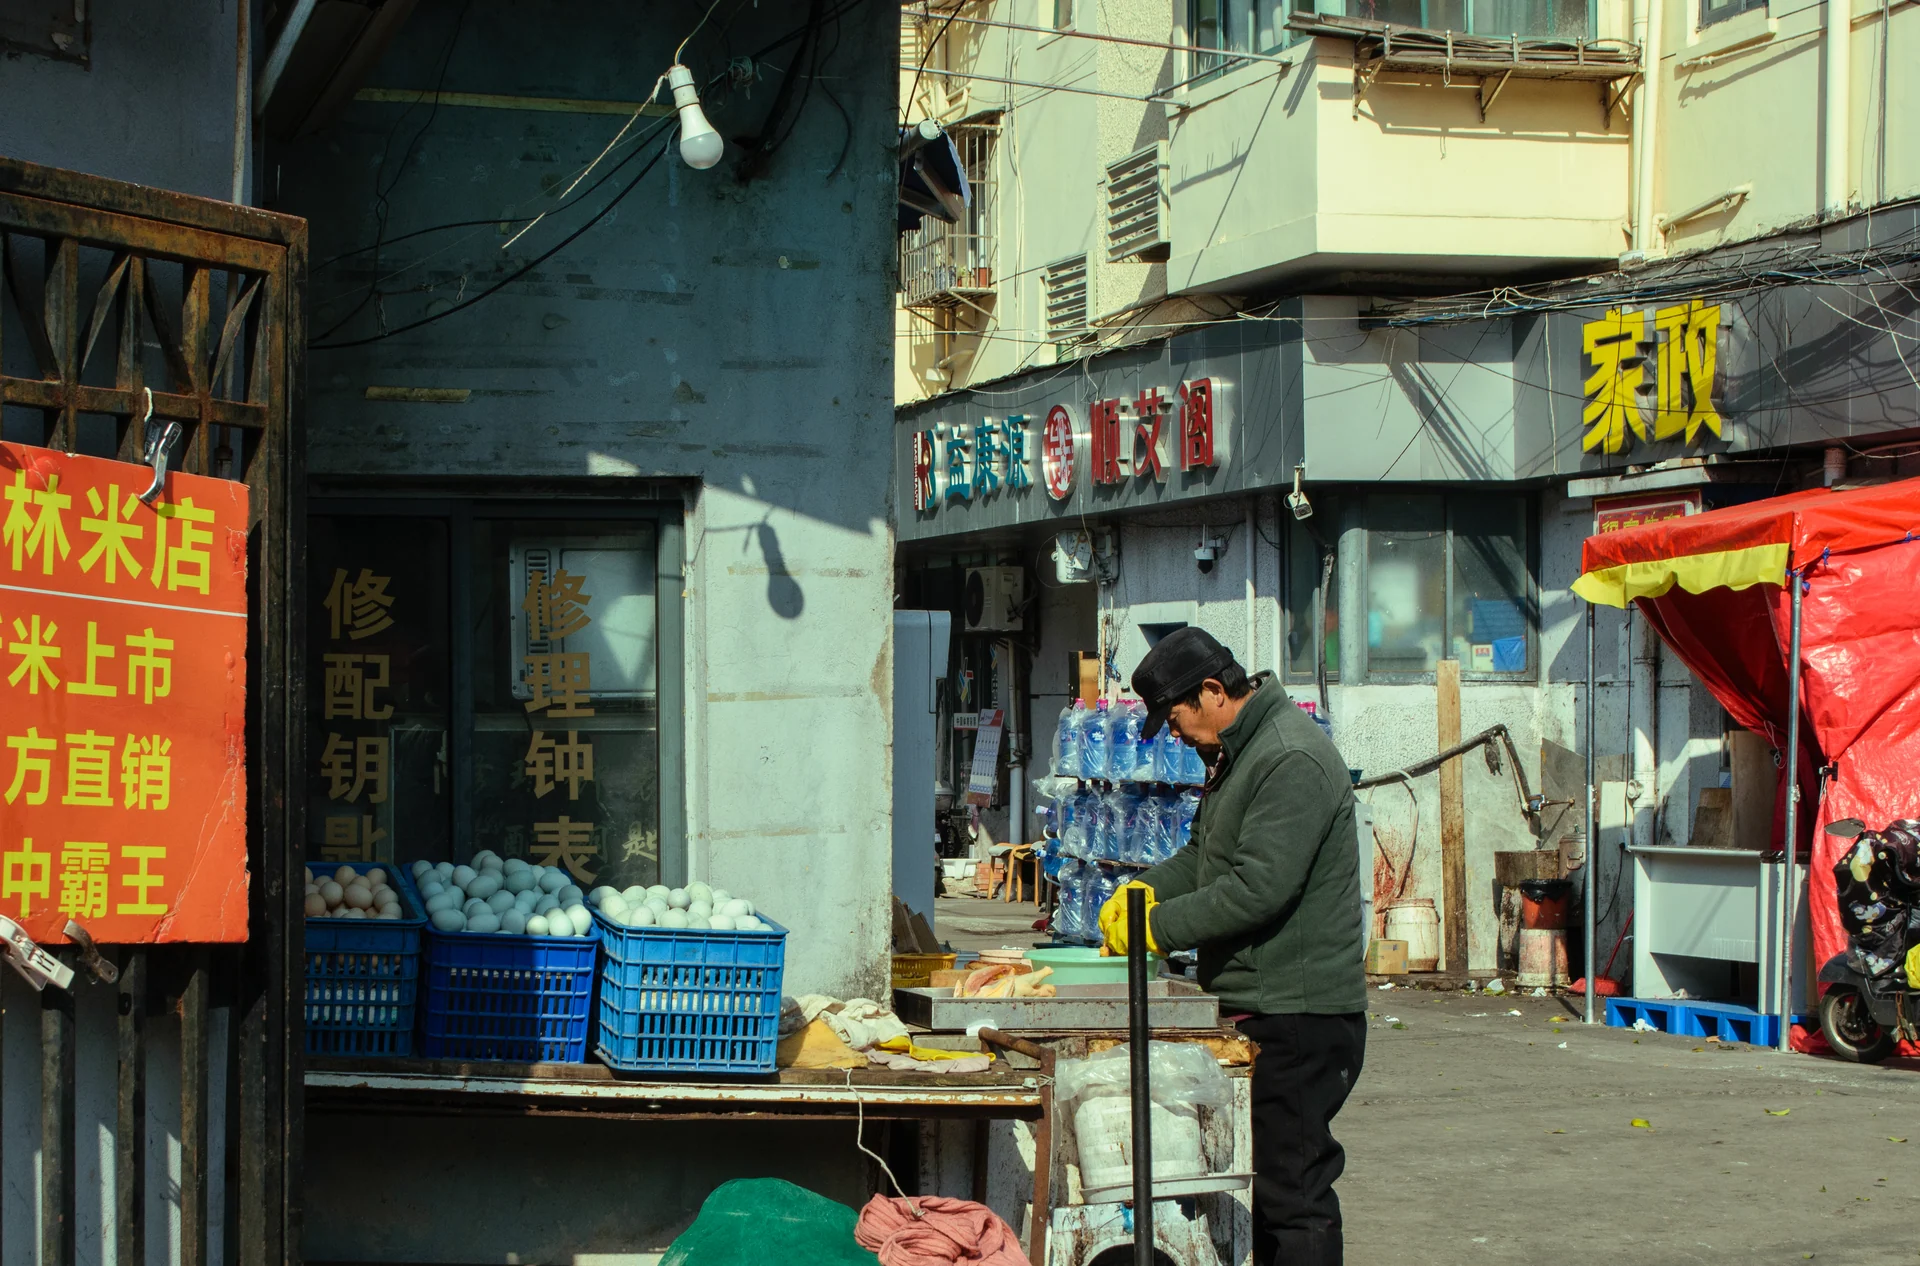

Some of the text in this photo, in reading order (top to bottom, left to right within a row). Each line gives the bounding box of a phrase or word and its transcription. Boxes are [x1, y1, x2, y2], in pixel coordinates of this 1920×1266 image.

[1583, 296, 1722, 454] 家政
[945, 414, 1026, 500] 益康源
[1090, 377, 1213, 486] 顺艾阁
[2, 470, 215, 596] 林米店
[0, 614, 174, 704] 米上市
[4, 727, 172, 811] 方直销
[320, 568, 396, 862] 修配钥匙
[521, 568, 599, 885] 修理钟表
[2, 837, 169, 920] 中霸王
